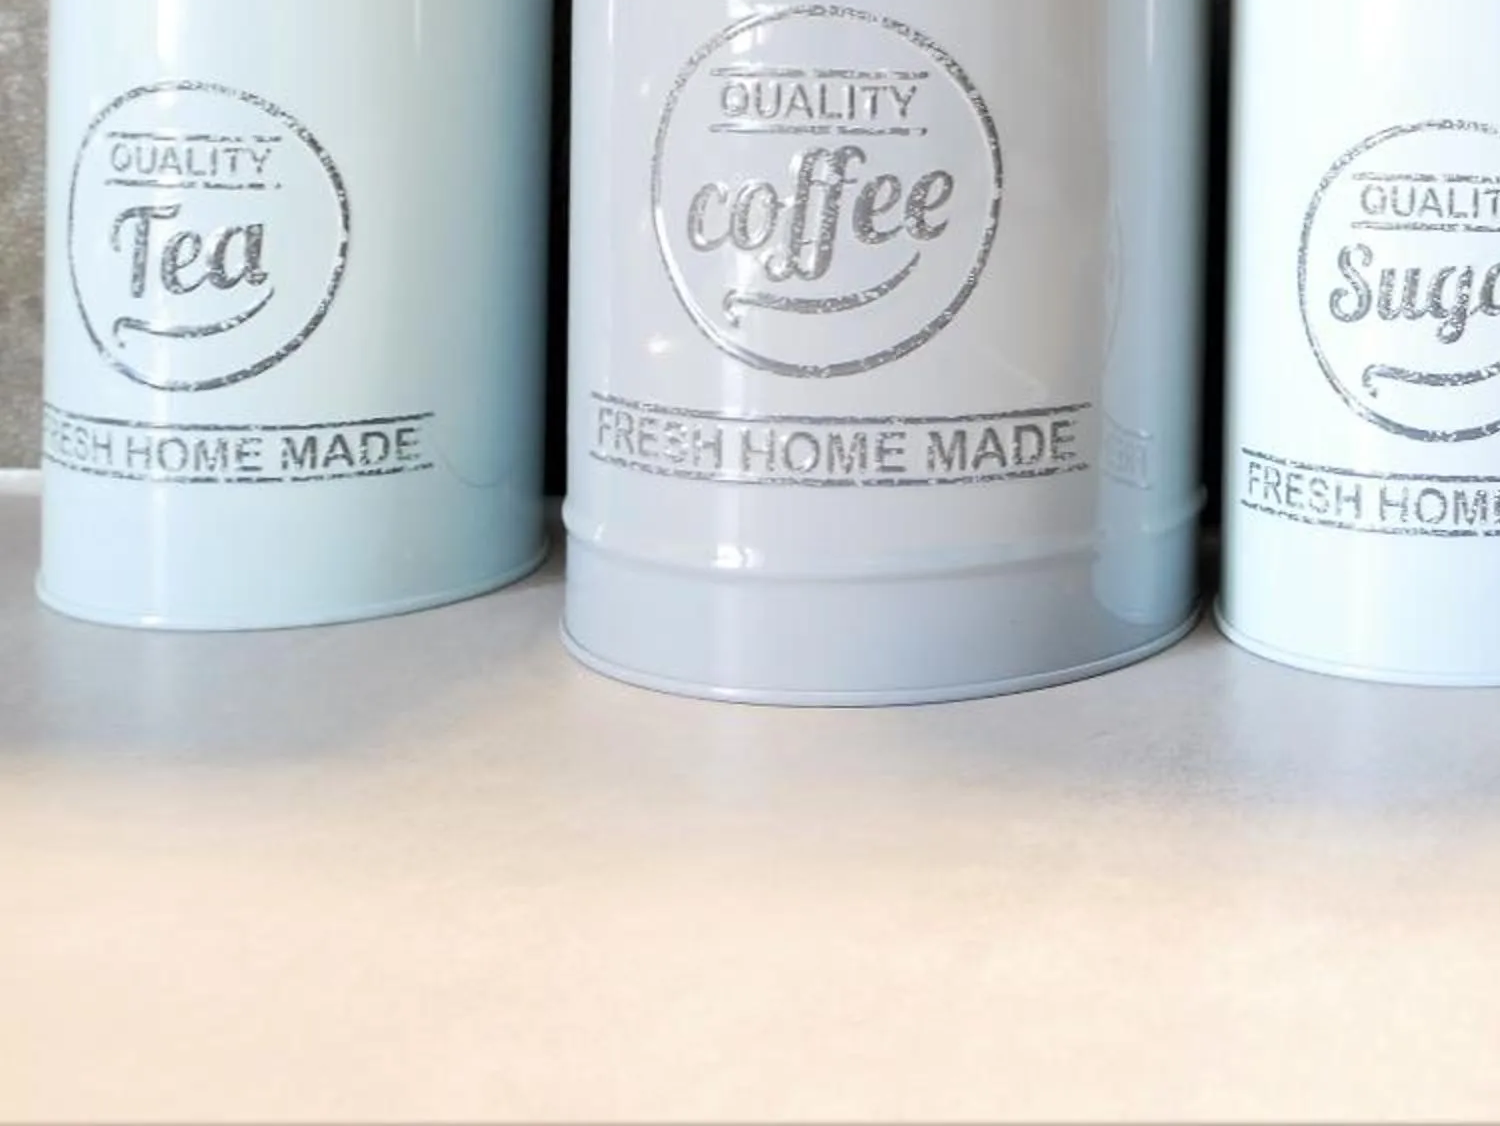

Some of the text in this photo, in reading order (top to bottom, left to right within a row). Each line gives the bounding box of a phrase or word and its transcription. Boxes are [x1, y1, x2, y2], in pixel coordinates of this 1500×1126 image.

[719, 82, 917, 120] QUALITY
[110, 140, 272, 175] QUALITY
[687, 145, 955, 282] coffee
[111, 203, 268, 299] Tea
[127, 436, 262, 473] HOME
[281, 427, 420, 471] MADE
[597, 407, 723, 470] FRESH
[741, 430, 905, 474] HOME
[926, 420, 1077, 472] MADE
[1247, 461, 1362, 519] FRESH
